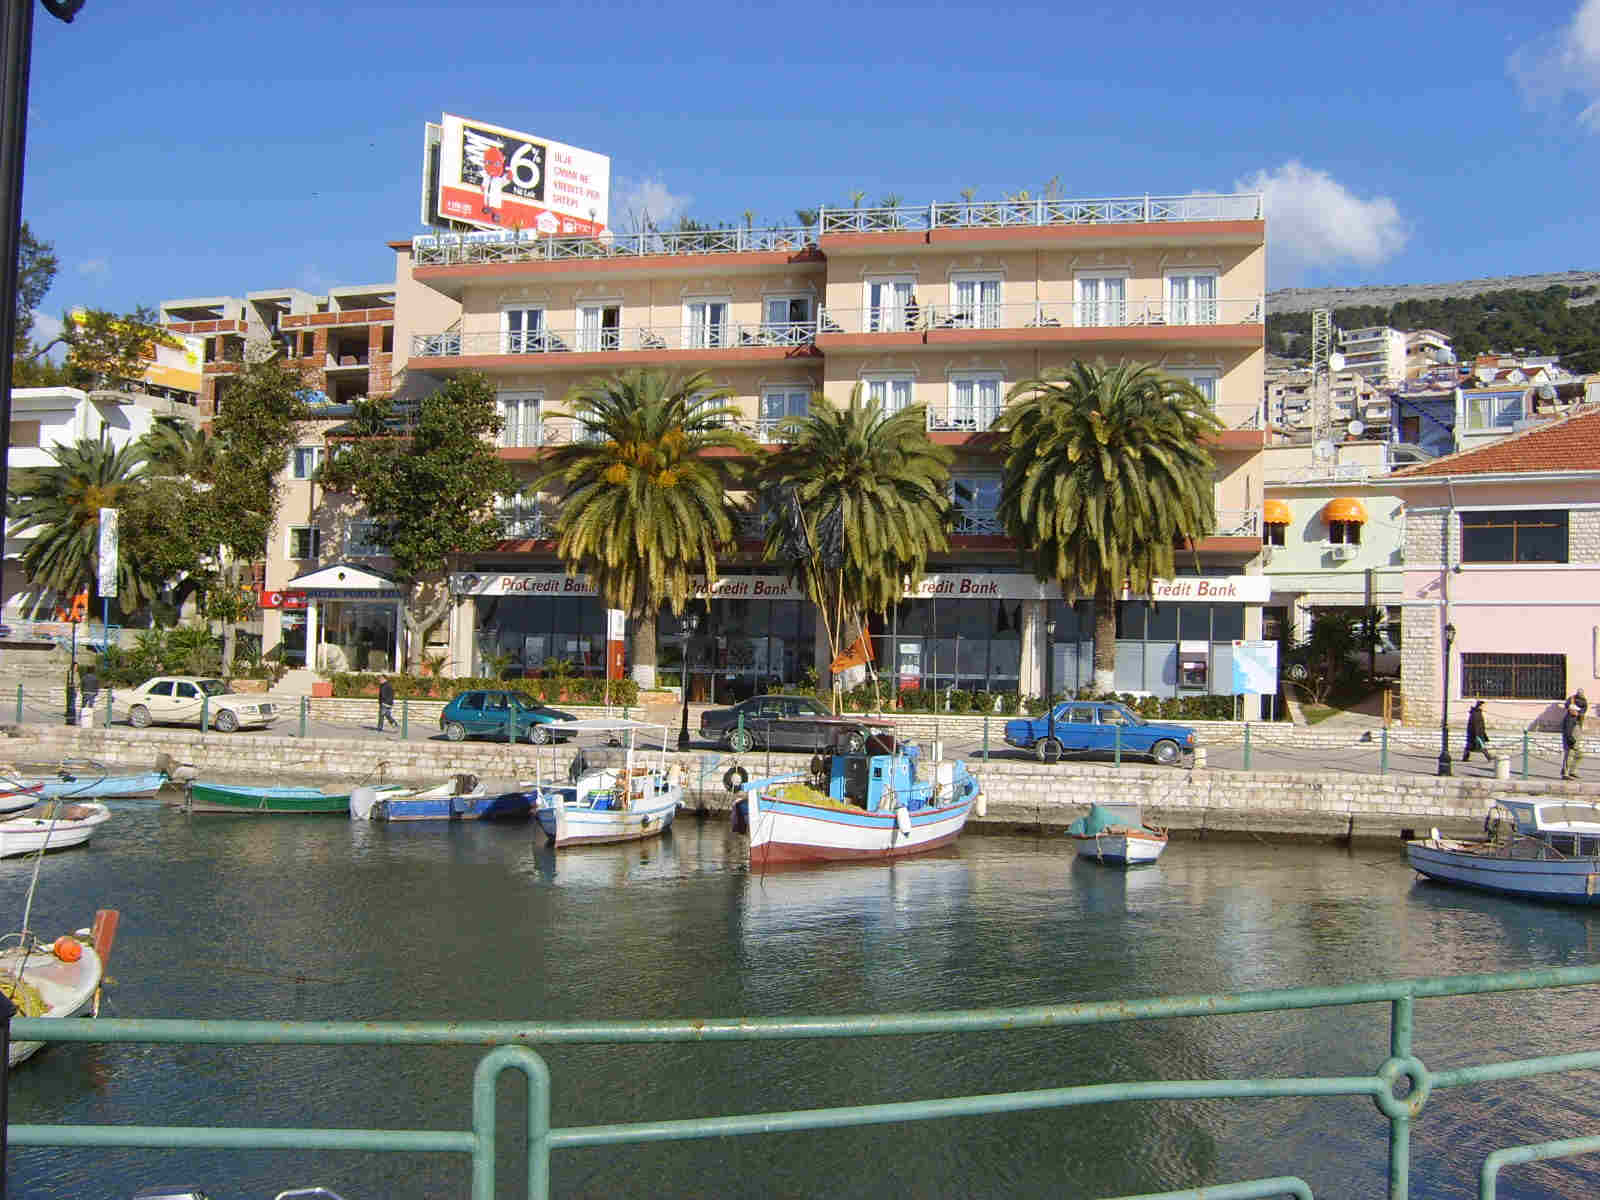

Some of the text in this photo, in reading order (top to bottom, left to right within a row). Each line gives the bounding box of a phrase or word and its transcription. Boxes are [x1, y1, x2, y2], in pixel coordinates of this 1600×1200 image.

[502, 578, 560, 592] ProCredit
[754, 580, 787, 594] Bank
[960, 579, 997, 593] Bank
[1198, 581, 1237, 597] Bank
